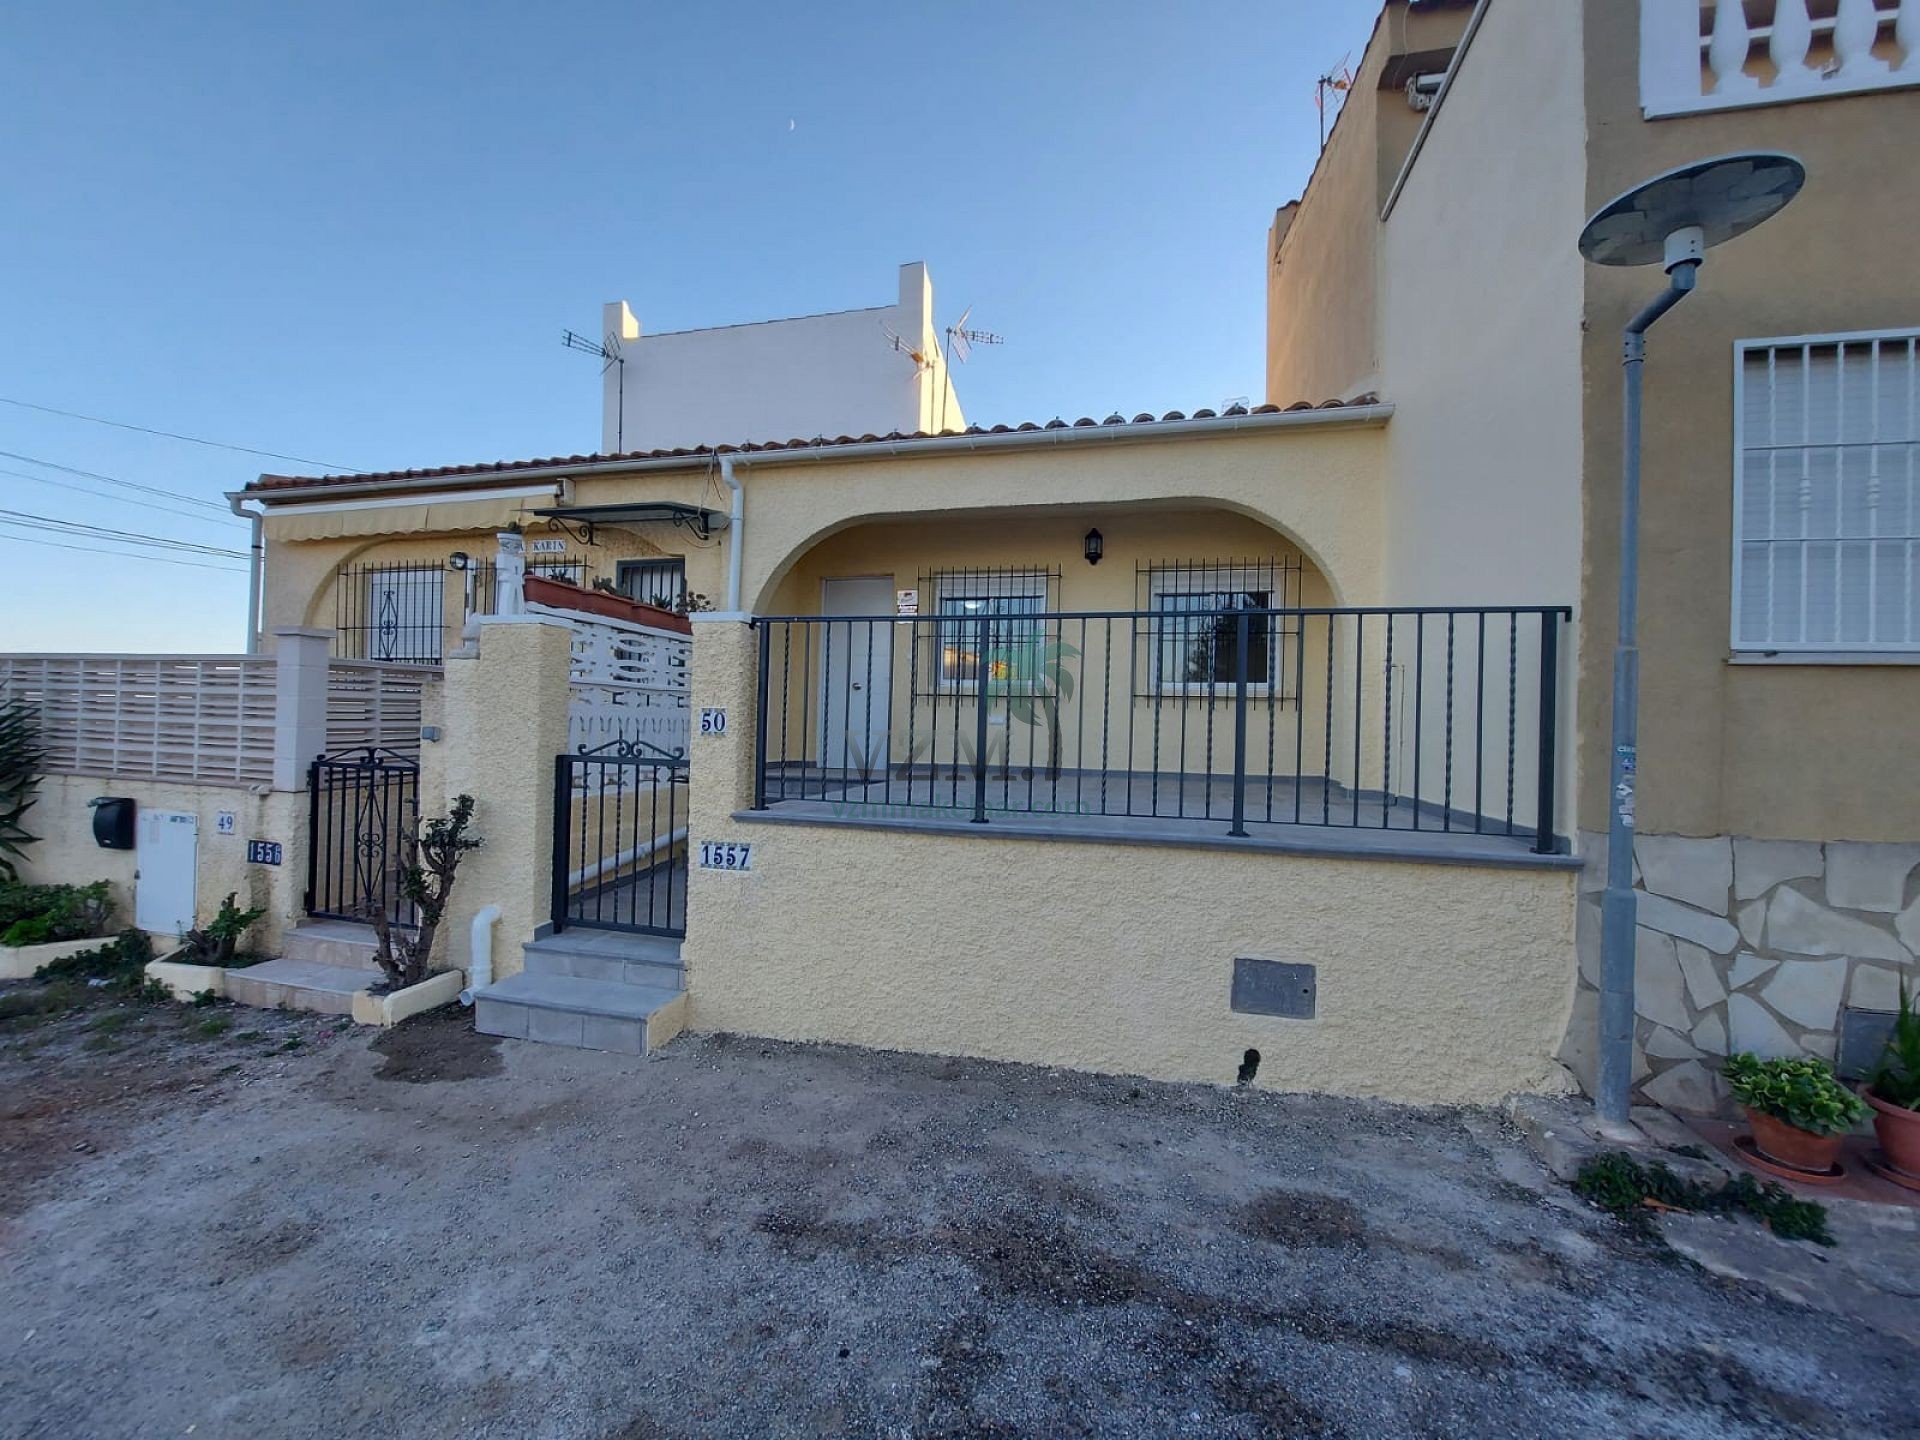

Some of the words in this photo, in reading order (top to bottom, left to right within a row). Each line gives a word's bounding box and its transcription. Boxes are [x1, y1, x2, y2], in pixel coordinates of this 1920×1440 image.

[701, 712, 726, 732] 50
[218, 815, 233, 830] 49
[249, 842, 281, 864] 1556
[702, 845, 750, 867] 1557
